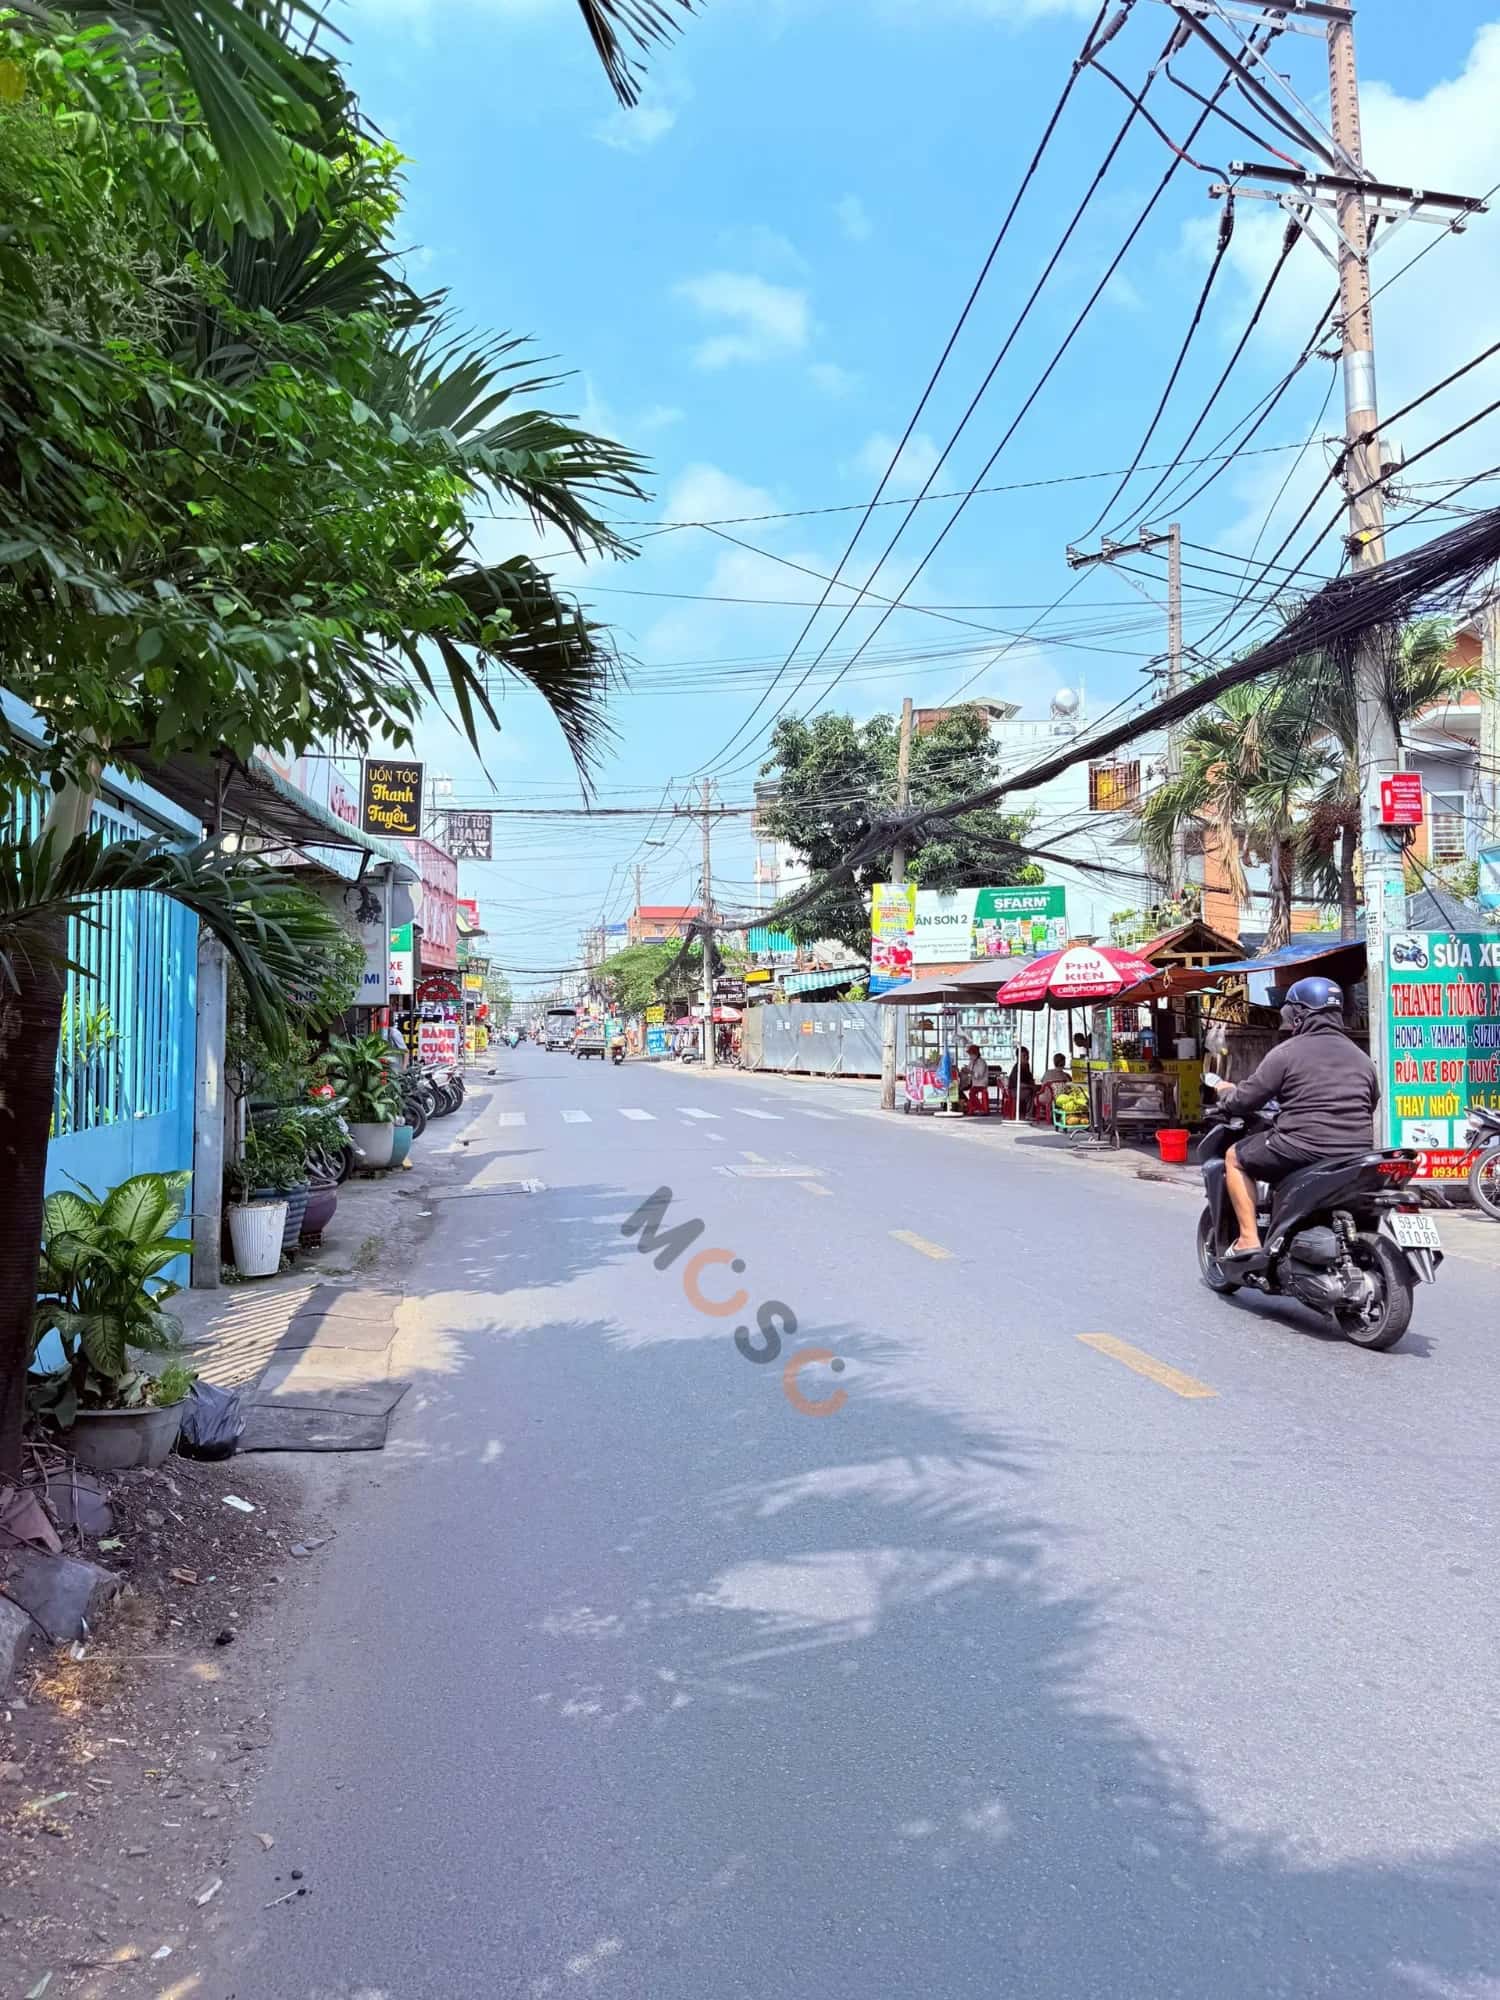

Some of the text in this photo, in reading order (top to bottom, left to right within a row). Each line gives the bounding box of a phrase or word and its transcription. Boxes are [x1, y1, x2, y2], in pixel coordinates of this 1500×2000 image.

[369, 766, 419, 784] UỐN TÓC
[371, 783, 415, 803] Thanh
[453, 828, 487, 841] NAM
[994, 896, 1047, 909] SFARM
[934, 914, 958, 926] SƠN
[960, 914, 968, 924] 2
[1433, 934, 1500, 968] SỬA XE
[1391, 983, 1443, 1018] THANH
[1446, 973, 1487, 1018] TÙNG
[1395, 1025, 1424, 1049] HONDA
[1431, 1024, 1467, 1048] YAMAHA
[1395, 1051, 1419, 1083] RỬA
[1422, 1060, 1437, 1083] XE
[1440, 1060, 1465, 1088] BỌT
[1395, 1095, 1425, 1117] THAY
[1429, 1090, 1461, 1117] NHỚT
